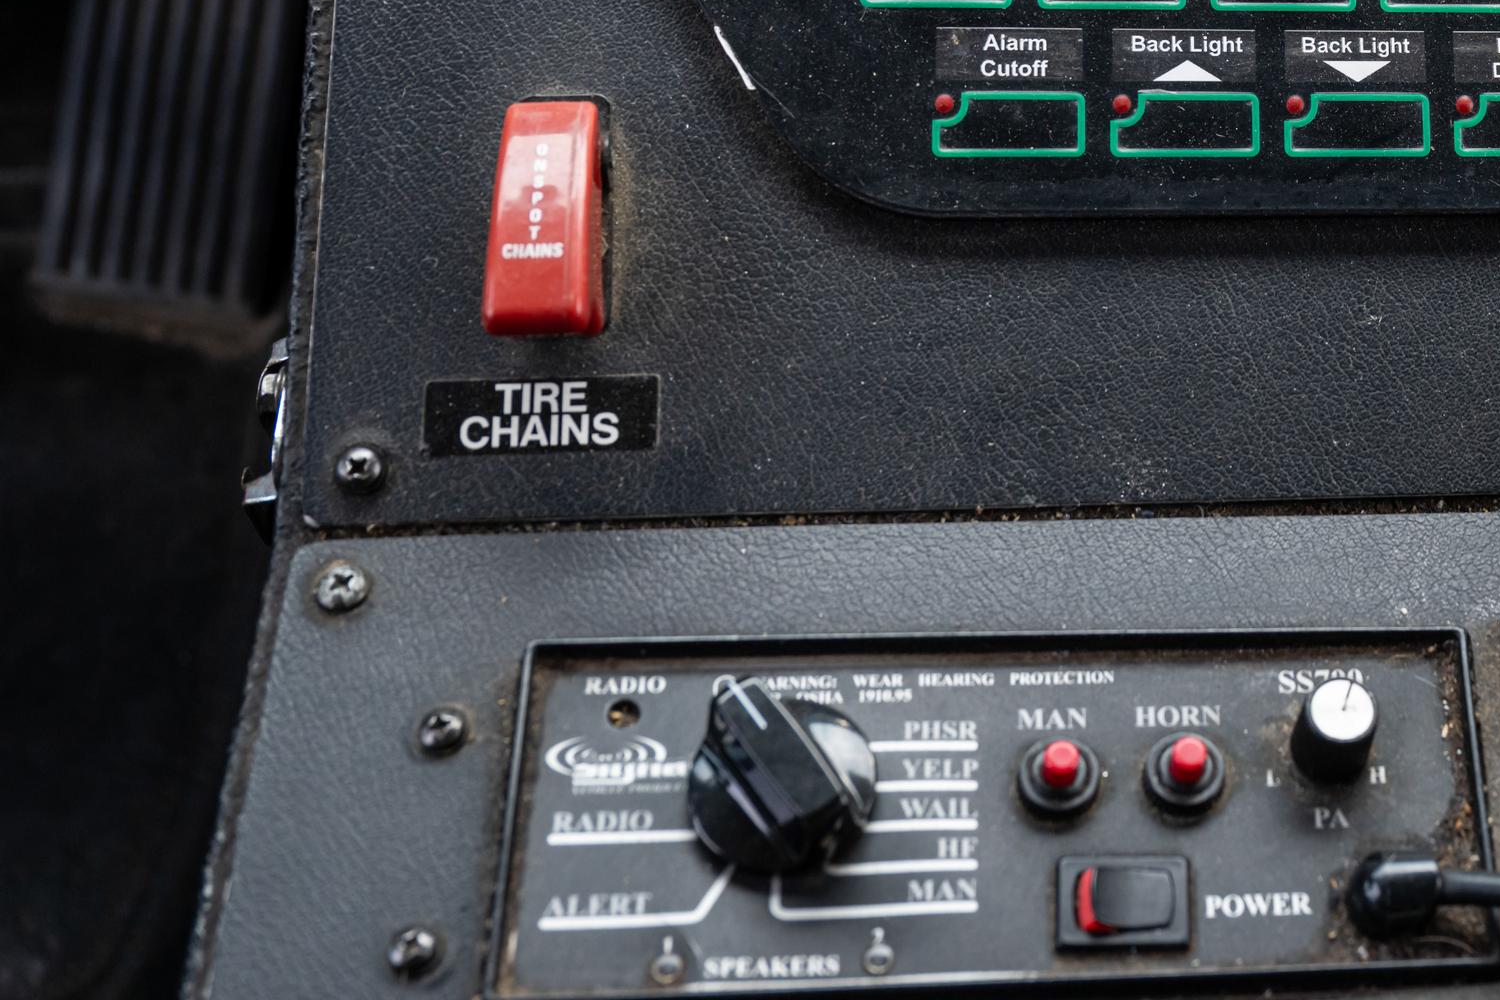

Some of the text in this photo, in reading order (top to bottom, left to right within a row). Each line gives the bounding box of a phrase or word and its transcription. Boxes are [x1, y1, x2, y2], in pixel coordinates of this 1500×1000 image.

[1131, 36, 1243, 57] Back Light
[1301, 37, 1410, 57] Back Light
[980, 59, 1048, 77] Cutoff
[502, 242, 564, 259] CHAINS
[495, 381, 588, 415] TIRE
[459, 412, 620, 450] CHAINS
[584, 675, 667, 697] RADIO
[764, 671, 1115, 691] ARNING: WEAR HEARING PROTECTION
[1017, 707, 1087, 730] MAN
[1135, 704, 1222, 728] HORN
[905, 720, 977, 741] PHSR
[902, 758, 979, 779] YELP
[1369, 765, 1387, 785] H
[900, 797, 978, 819] WAIL
[1314, 805, 1350, 829] PA
[553, 810, 653, 833] RADIO
[938, 837, 976, 859] HF
[907, 878, 976, 902] MAN
[544, 892, 651, 916] ALERT
[1205, 892, 1313, 919] POWER
[703, 954, 840, 979] SPEAKERS
